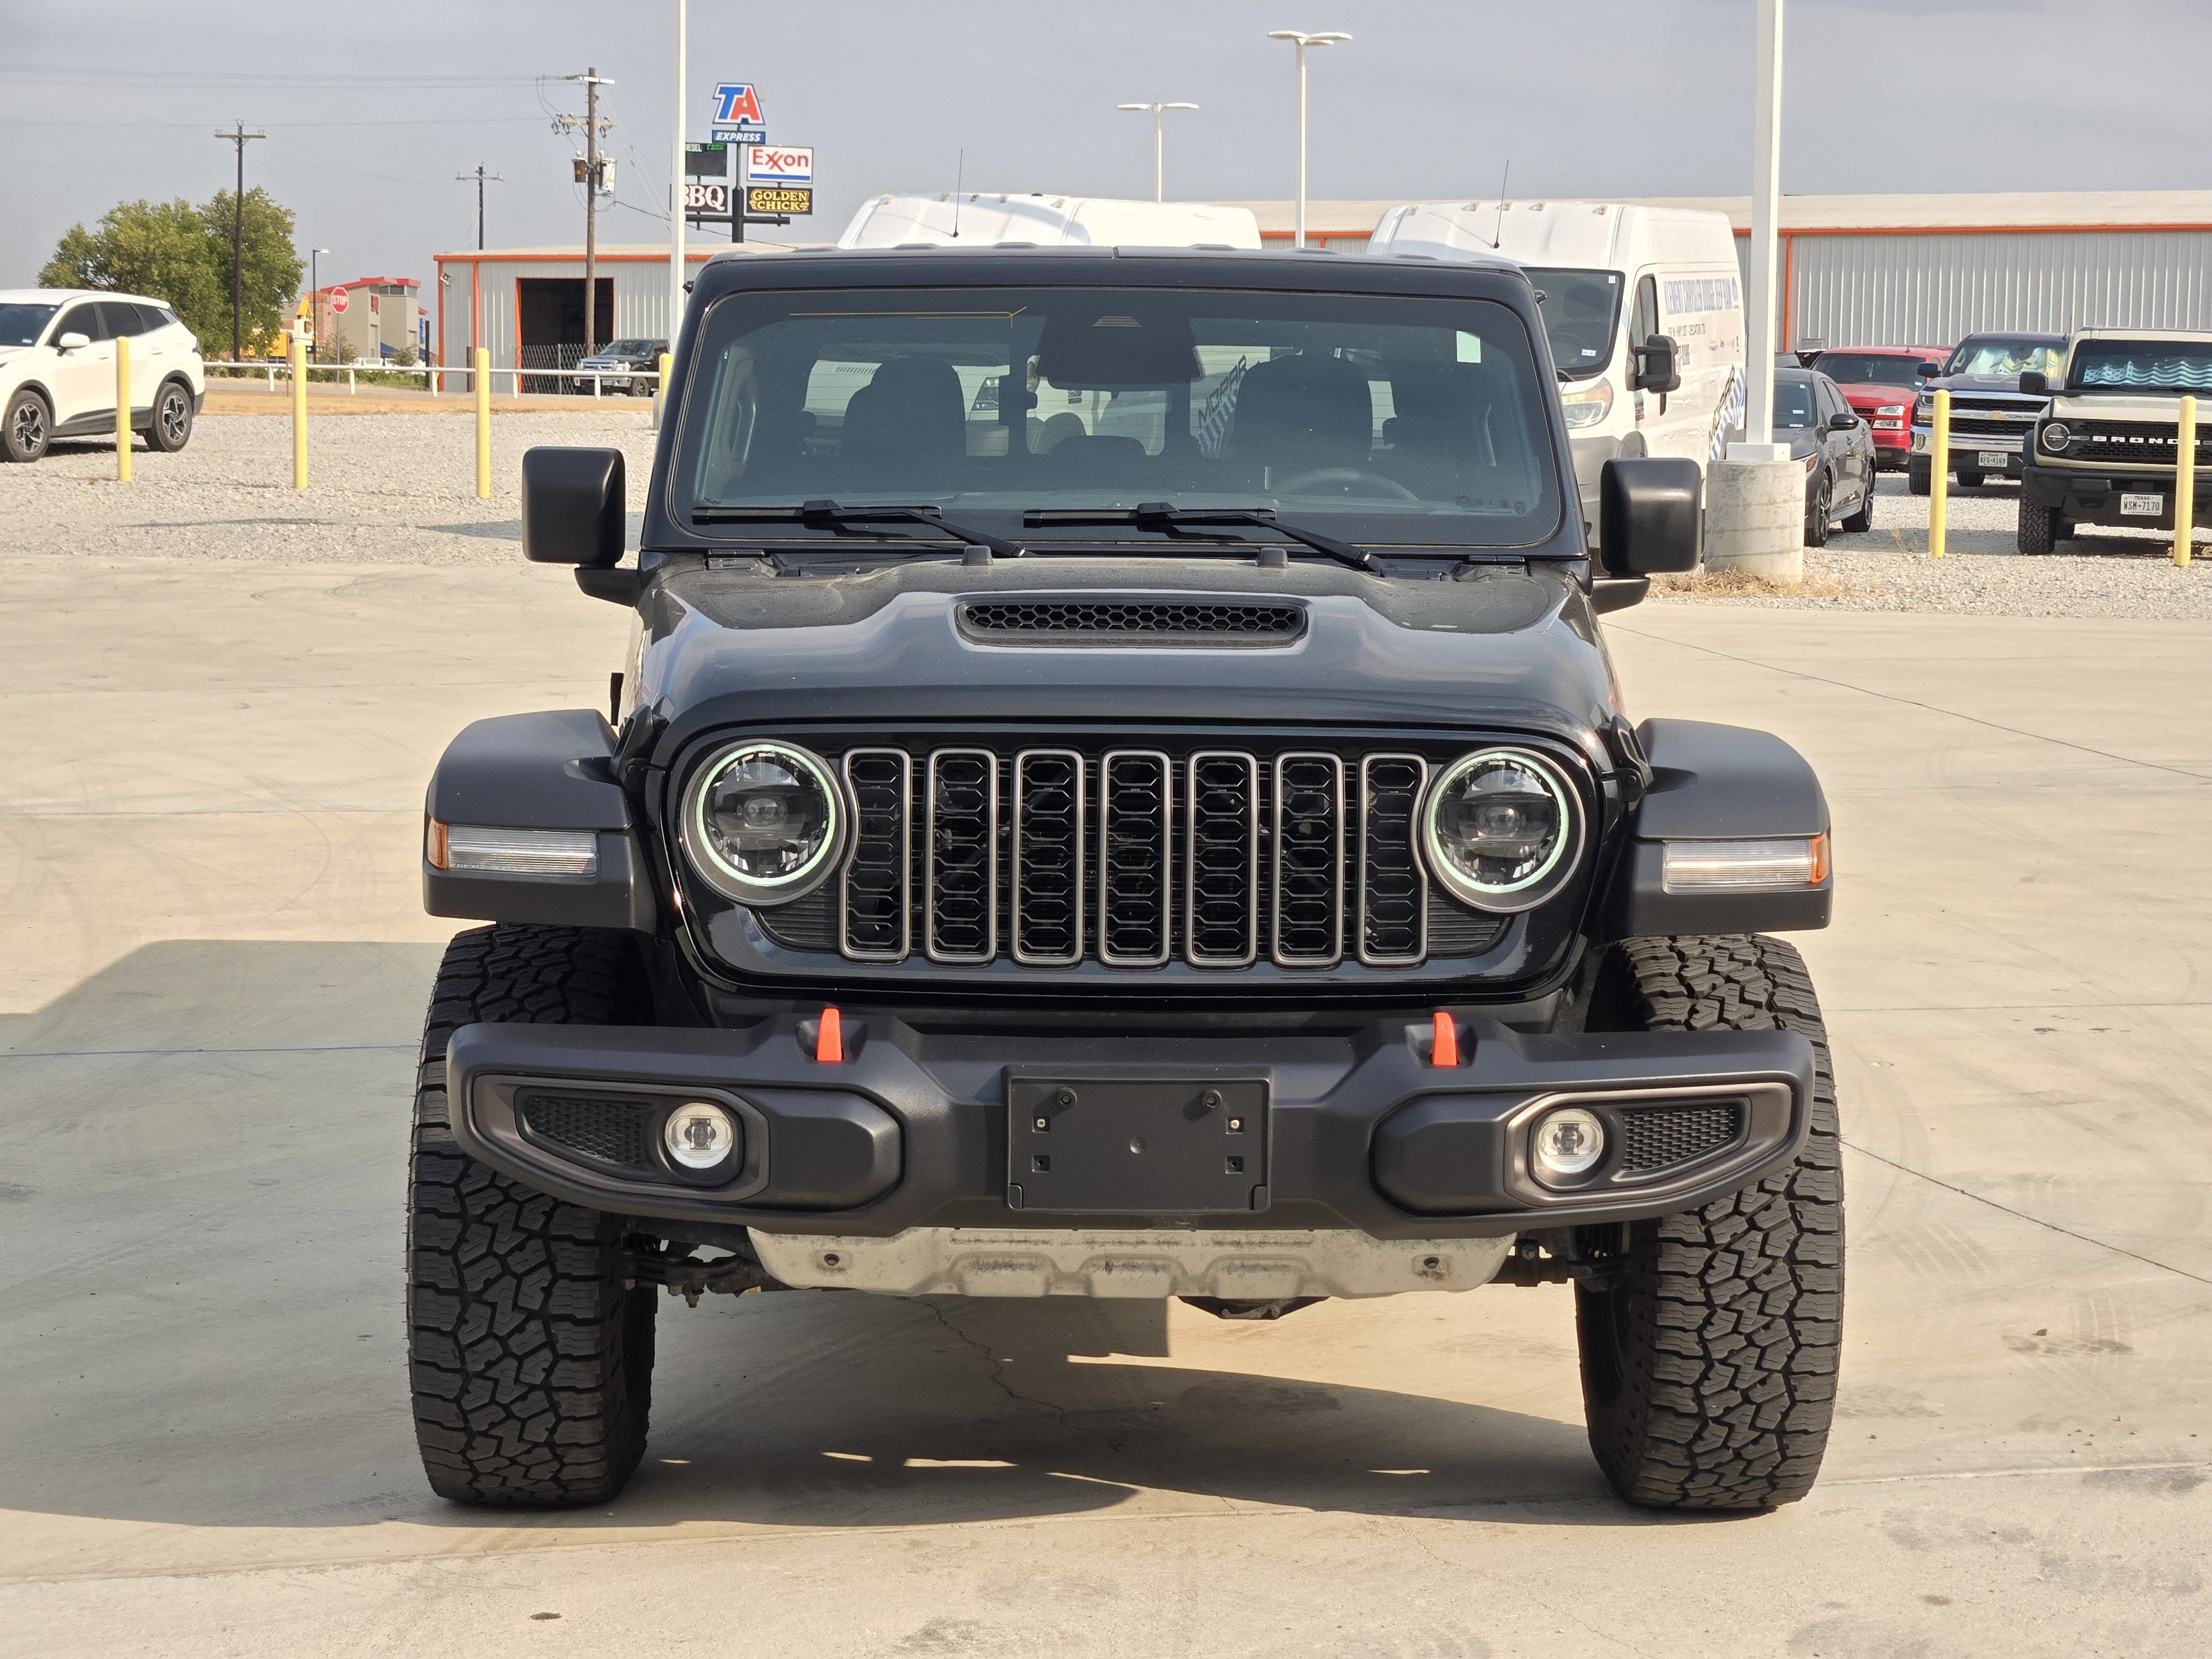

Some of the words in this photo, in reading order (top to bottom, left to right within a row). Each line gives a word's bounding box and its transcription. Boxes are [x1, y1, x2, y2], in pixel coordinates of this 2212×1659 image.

[717, 85, 761, 121] TA
[716, 132, 761, 142] EXPRESS
[753, 149, 809, 173] Exxon
[752, 191, 808, 201] GOLDEN
[757, 201, 801, 211] CHICK
[332, 295, 348, 306] STOP
[1198, 354, 1248, 430] MOPAR
